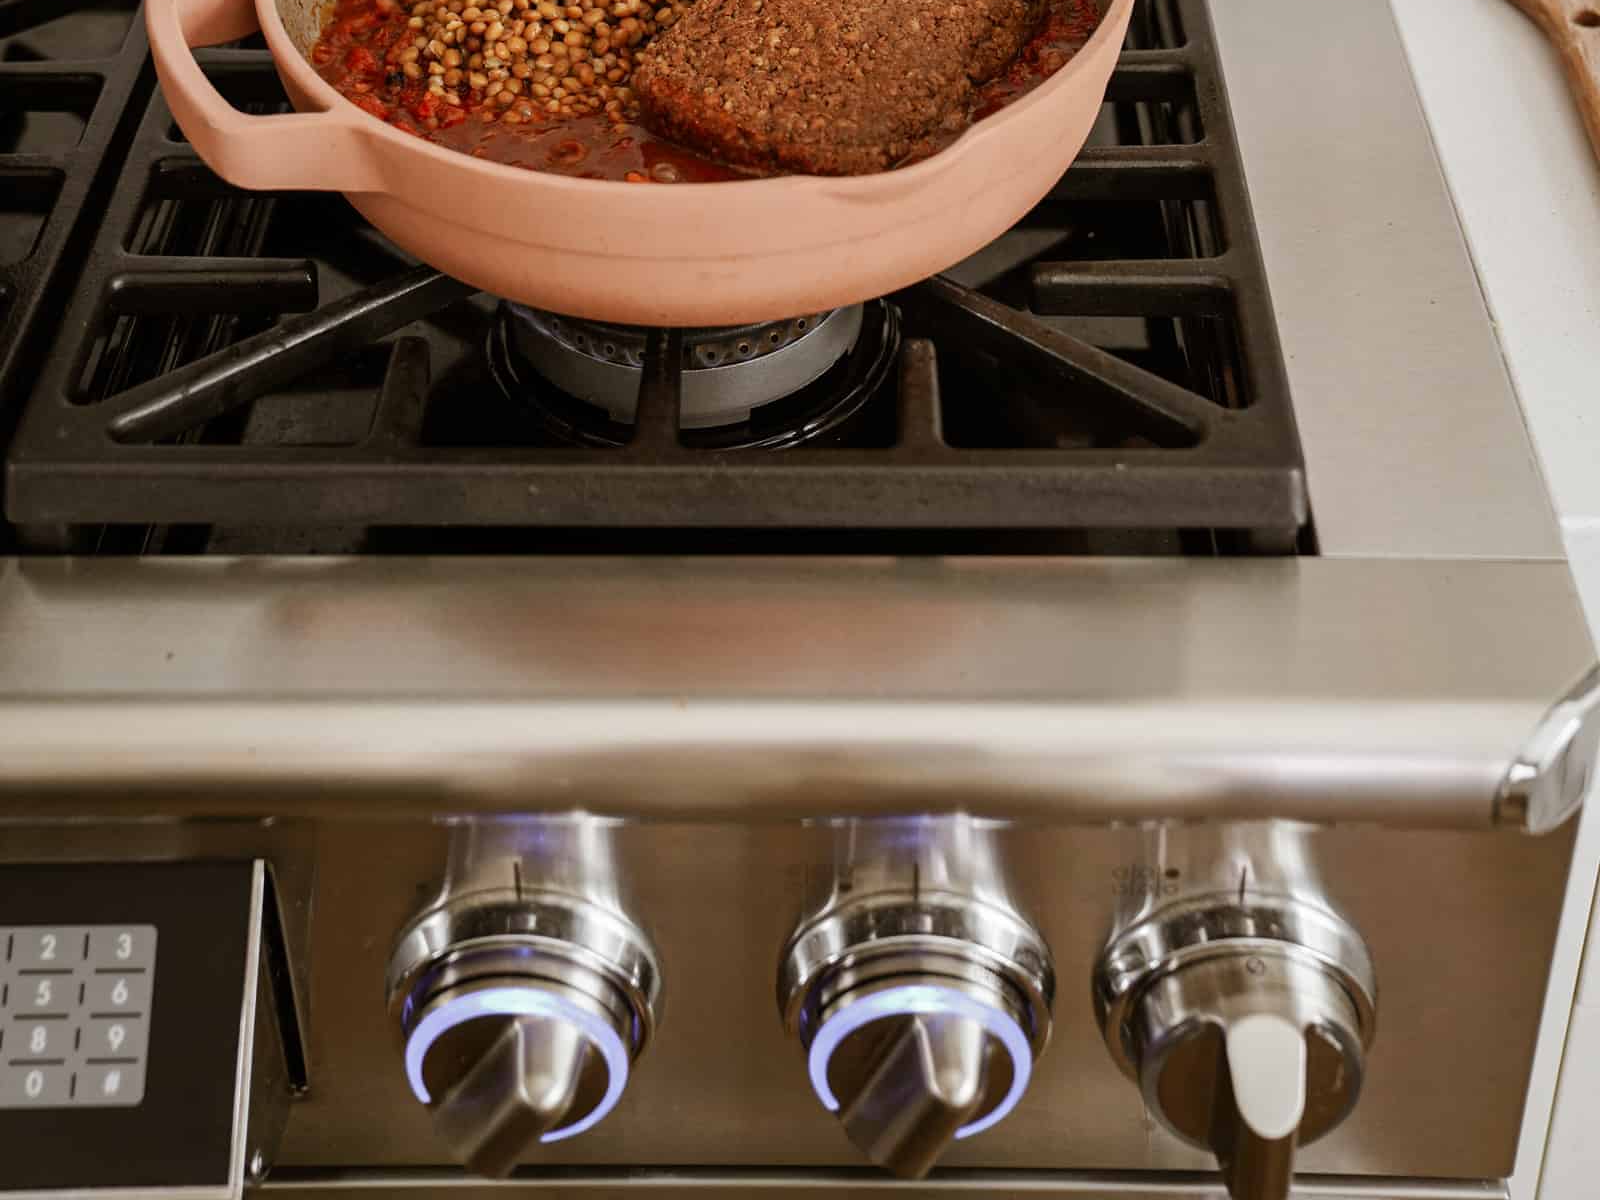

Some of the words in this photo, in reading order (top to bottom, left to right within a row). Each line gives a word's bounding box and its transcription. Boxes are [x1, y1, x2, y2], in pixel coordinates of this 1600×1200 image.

[41, 934, 56, 960] 2
[117, 933, 132, 959] 3
[36, 980, 51, 1006] 5
[112, 979, 128, 1005] 6
[30, 1026, 46, 1053] 8
[108, 1024, 126, 1051] 9
[25, 1069, 43, 1097] 0
[103, 1070, 121, 1095] #
